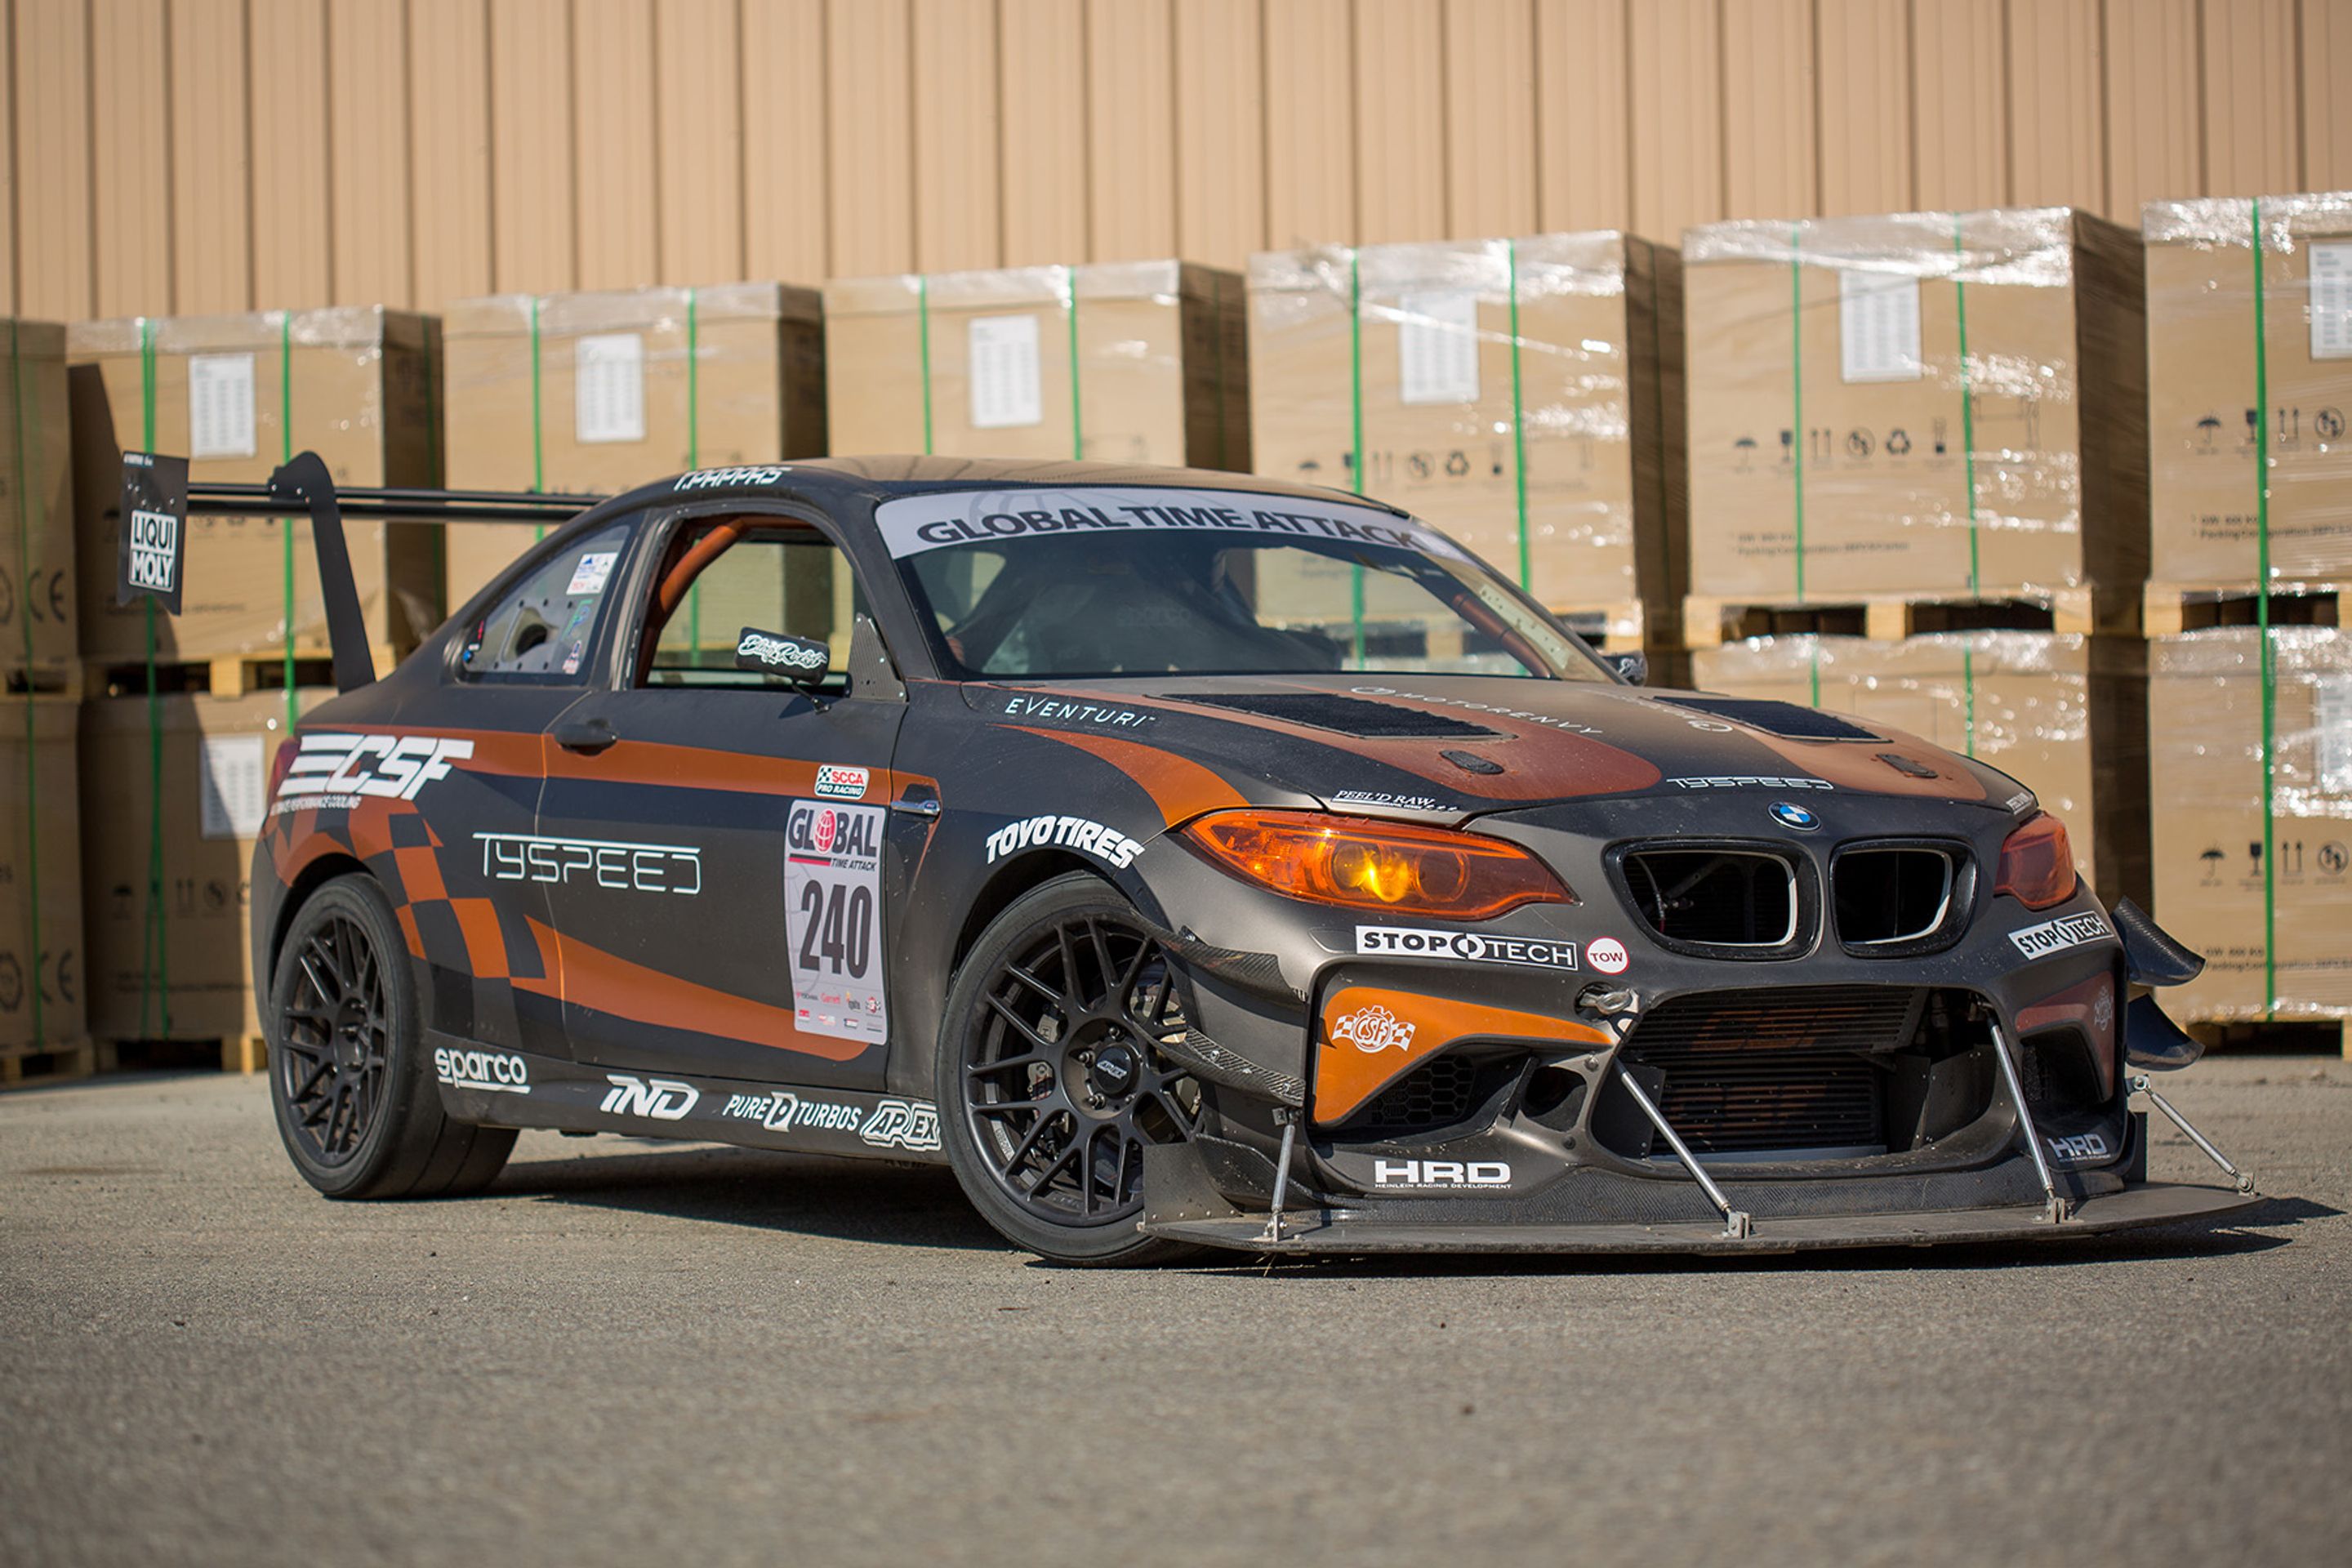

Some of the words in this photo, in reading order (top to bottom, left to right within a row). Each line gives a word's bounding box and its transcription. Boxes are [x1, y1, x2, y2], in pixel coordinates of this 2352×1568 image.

[134, 516, 174, 550] LIQUI
[917, 505, 1128, 545] GLOBAL
[1120, 506, 1250, 529] TIME
[1253, 510, 1430, 551] ATTACK
[131, 550, 174, 587] MOLY
[1004, 696, 1147, 728] EVENTURI
[817, 783, 831, 792] PRO
[833, 785, 862, 795] RACING
[831, 771, 865, 785] SCCA
[1393, 795, 1436, 807] RAW
[788, 808, 877, 858] GLOBAL
[986, 815, 1057, 864] TOYO
[1054, 816, 1145, 869] TIRES
[831, 859, 848, 868] TIME
[848, 861, 876, 871] ATTACK
[800, 879, 871, 980] 240
[1590, 951, 1624, 963] TOW
[1356, 1017, 1389, 1044] CSF
[434, 1046, 528, 1089] sparco
[722, 1094, 772, 1120] PURE
[794, 1102, 862, 1132] TURBOS
[864, 1103, 940, 1146] APEX
[2047, 1134, 2107, 1157] HRD
[1374, 1160, 1511, 1183] HRD
